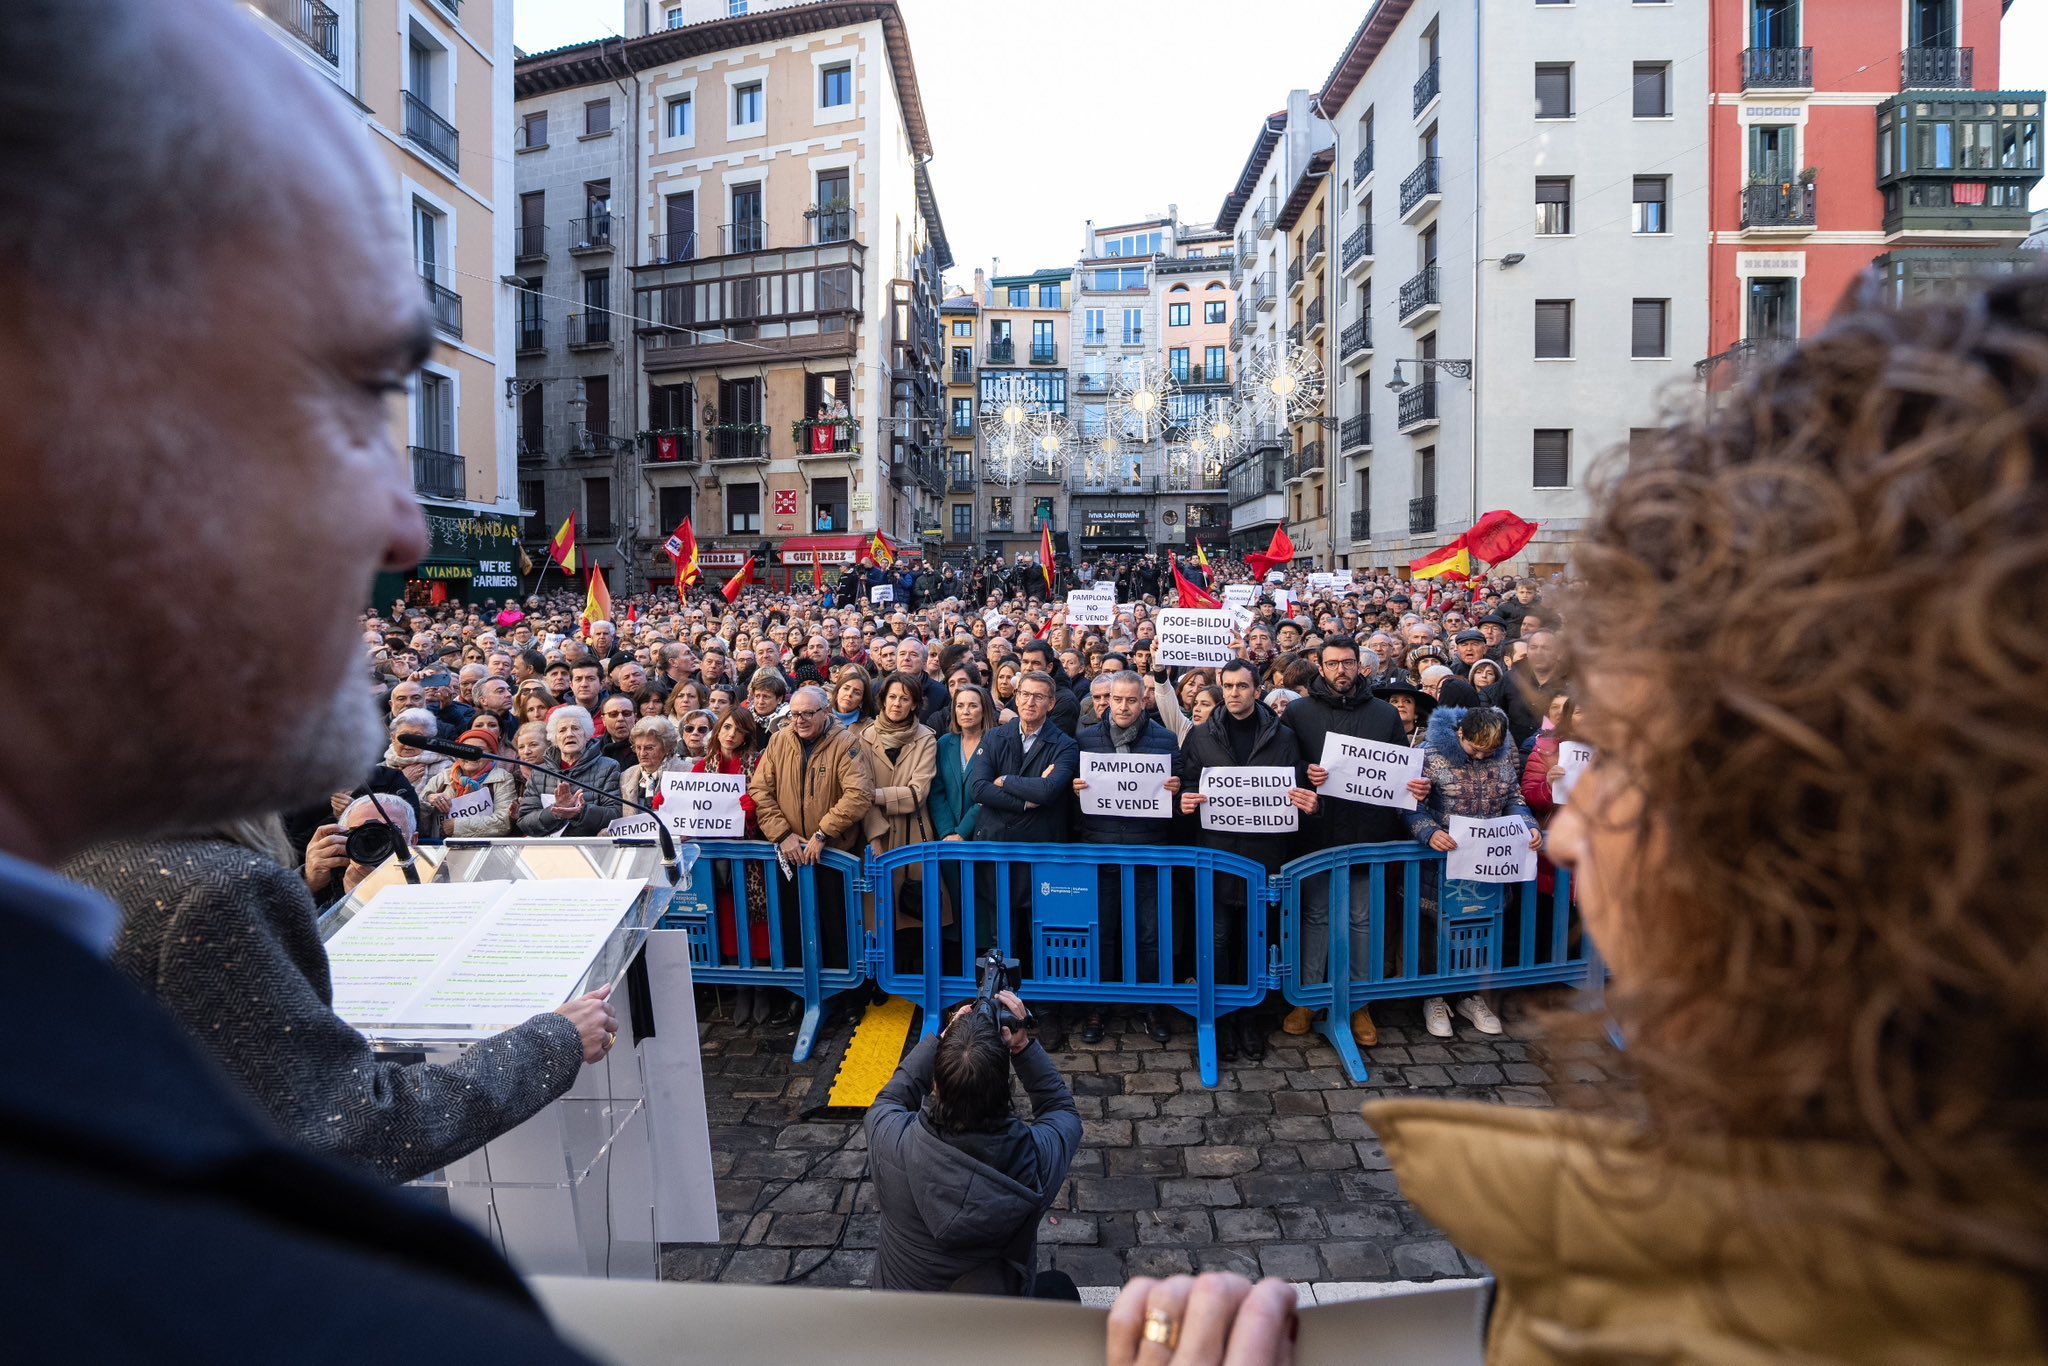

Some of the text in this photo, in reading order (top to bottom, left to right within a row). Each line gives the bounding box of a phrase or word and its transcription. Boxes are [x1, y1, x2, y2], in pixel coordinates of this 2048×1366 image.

[458, 520, 518, 538] VIANDAS
[793, 552, 846, 561] GUTERREZ
[425, 566, 473, 578] VIANDAS
[480, 561, 511, 573] WE'RE
[473, 575, 518, 587] FARMERS
[1163, 616, 1231, 628] PSOE=BILDU
[1162, 633, 1231, 646] PSOE=BILDU
[1162, 651, 1232, 662] PSOE=BILDU
[1341, 743, 1409, 765] TRAICIÓN
[1090, 761, 1165, 774] PAMPLONA
[1357, 766, 1387, 781] POR
[670, 780, 740, 793] PAMPLONA
[1117, 781, 1138, 791] NO
[1208, 776, 1292, 788] PSOE=BILDU
[1345, 782, 1394, 800] SILLÓN
[692, 800, 712, 811] NO
[1097, 797, 1159, 810] SE VENDE
[1209, 796, 1293, 808] PSOE=BILDU
[673, 817, 732, 830] SE VENDE
[1210, 814, 1294, 826] PSOE=BILDU
[1469, 821, 1524, 839] TRAICIÓN
[1486, 845, 1512, 857] POR
[1474, 862, 1519, 876] SILLÓN
